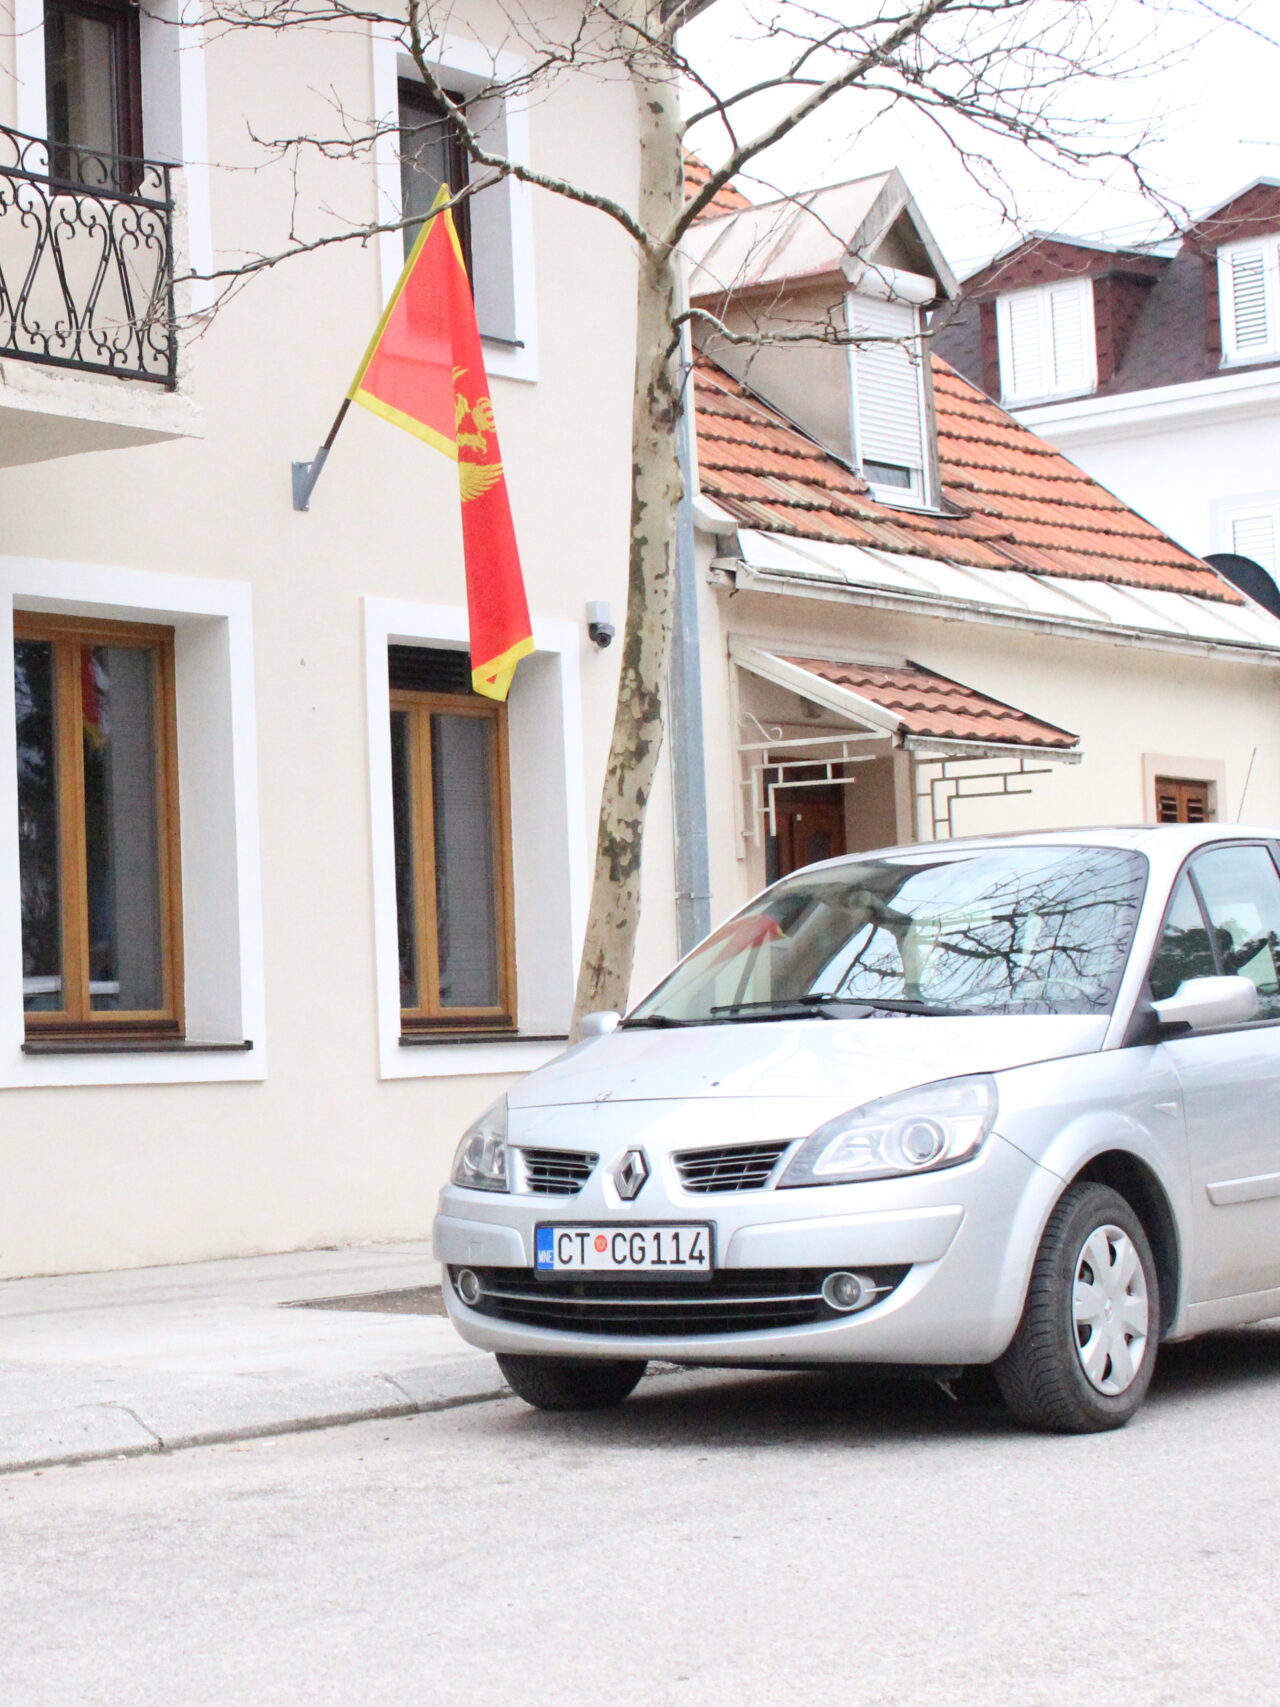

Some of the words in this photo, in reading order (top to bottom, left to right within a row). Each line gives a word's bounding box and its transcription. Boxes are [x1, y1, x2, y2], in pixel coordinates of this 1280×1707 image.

[538, 1249, 554, 1264] MNE
[558, 1232, 590, 1265] CT
[611, 1231, 705, 1265] CG114
